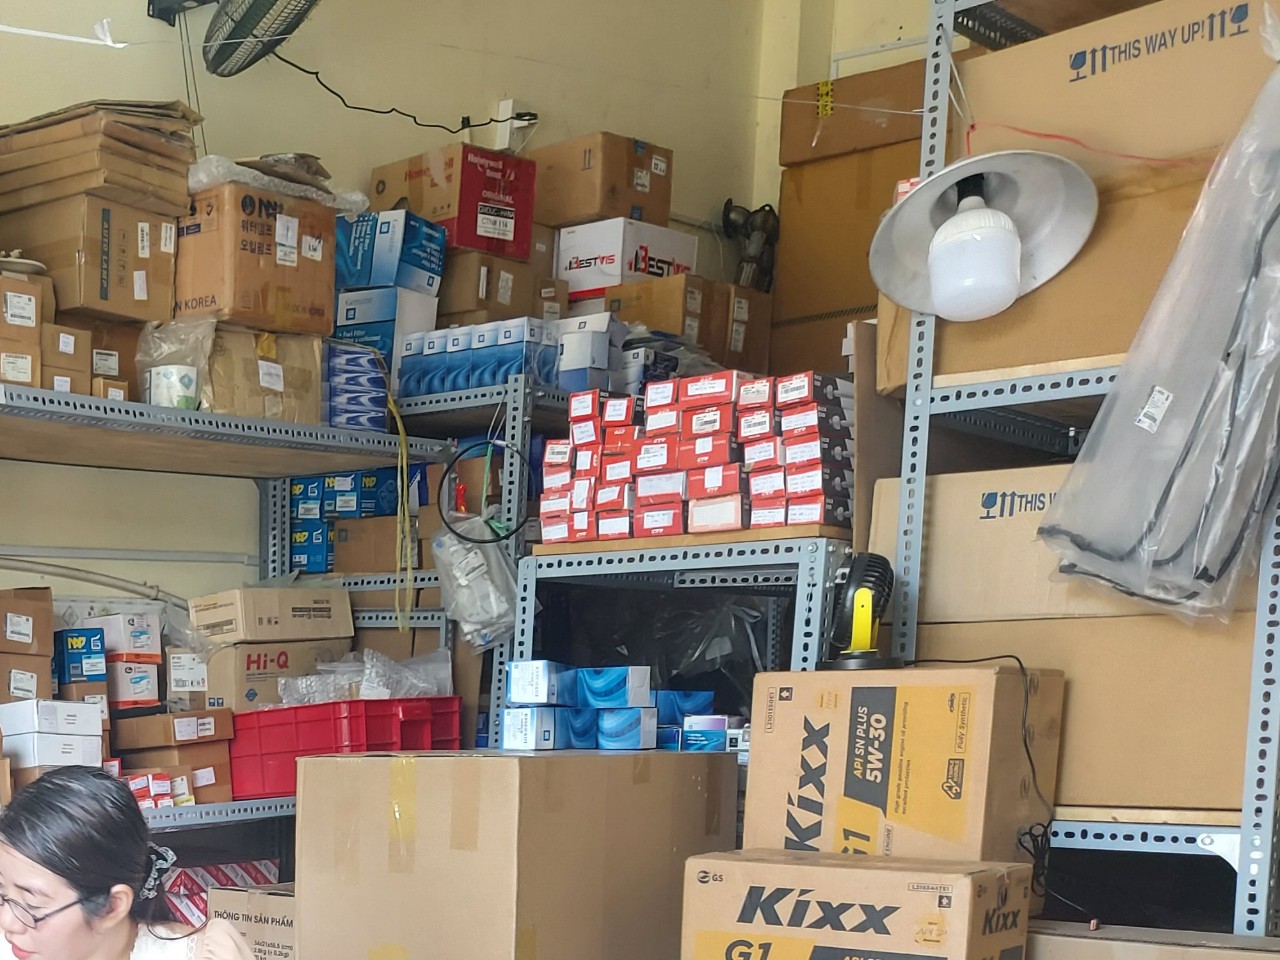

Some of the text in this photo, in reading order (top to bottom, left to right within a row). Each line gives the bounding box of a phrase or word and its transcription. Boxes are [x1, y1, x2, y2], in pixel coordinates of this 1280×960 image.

[1109, 20, 1205, 65] THIS WAY UP!
[100, 255, 108, 288] LAMP
[185, 295, 217, 310] KOREA
[1018, 492, 1046, 512] THIS
[246, 651, 289, 671] Hi-Q
[957, 696, 968, 750] Fully Synthetic
[853, 706, 868, 779] API SN PLUS
[866, 713, 887, 784] 5W-30
[784, 715, 830, 852] Kixx
[884, 827, 892, 852] ENGINE
[712, 874, 724, 882] GS
[214, 909, 240, 922] THÔNG
[242, 914, 252, 922] TIN
[253, 912, 269, 924] SẢN
[737, 886, 902, 935] Kixx
[982, 909, 1020, 936] Kixx
